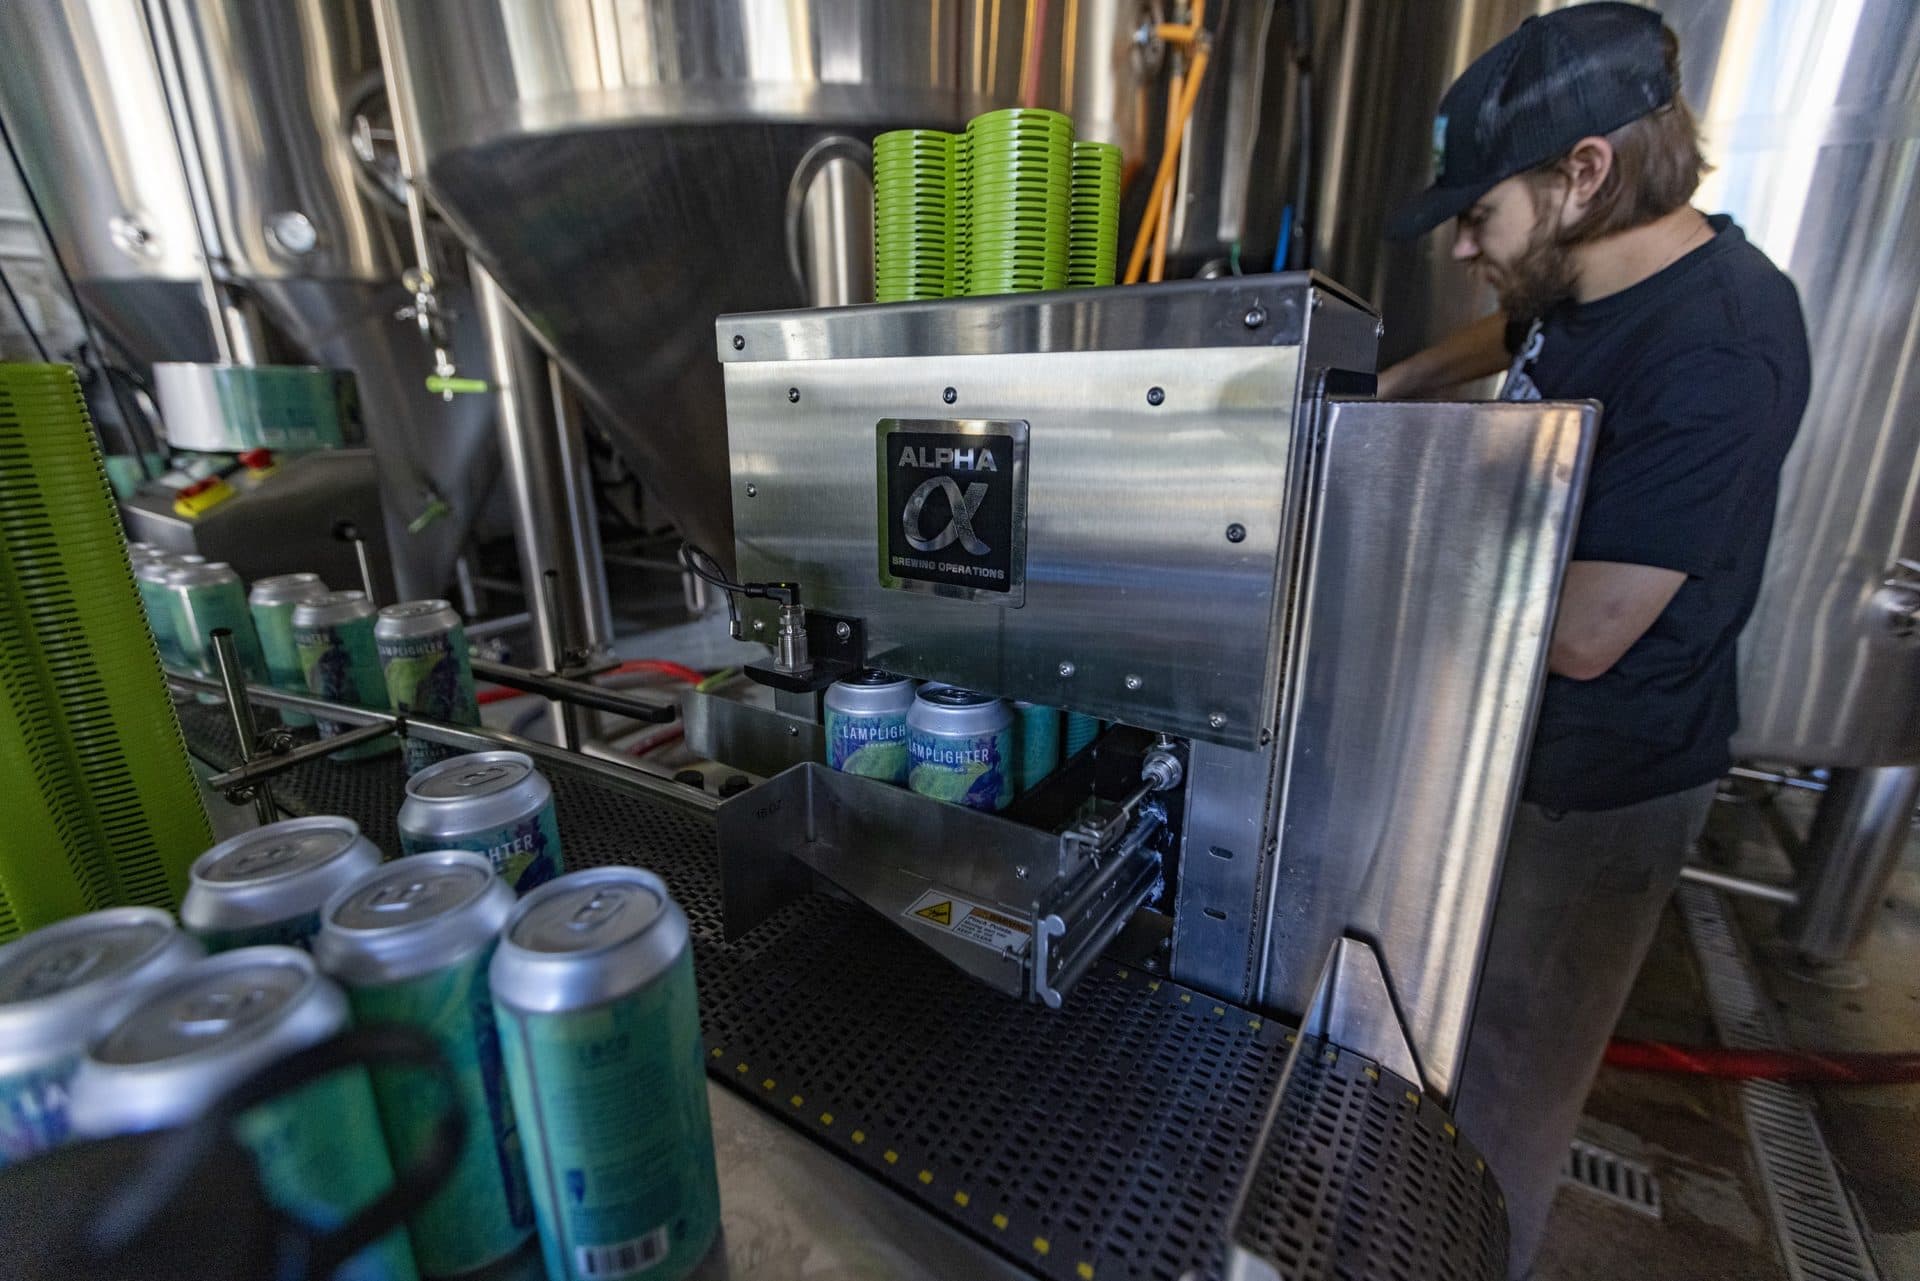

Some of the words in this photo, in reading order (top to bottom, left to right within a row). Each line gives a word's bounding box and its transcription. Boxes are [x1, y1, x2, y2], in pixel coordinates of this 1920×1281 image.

[898, 446, 998, 472] ALPHA
[892, 556, 936, 571] BREWING
[938, 563, 1005, 579] OPERATIONS
[908, 737, 989, 765] LAMPLIGHTER
